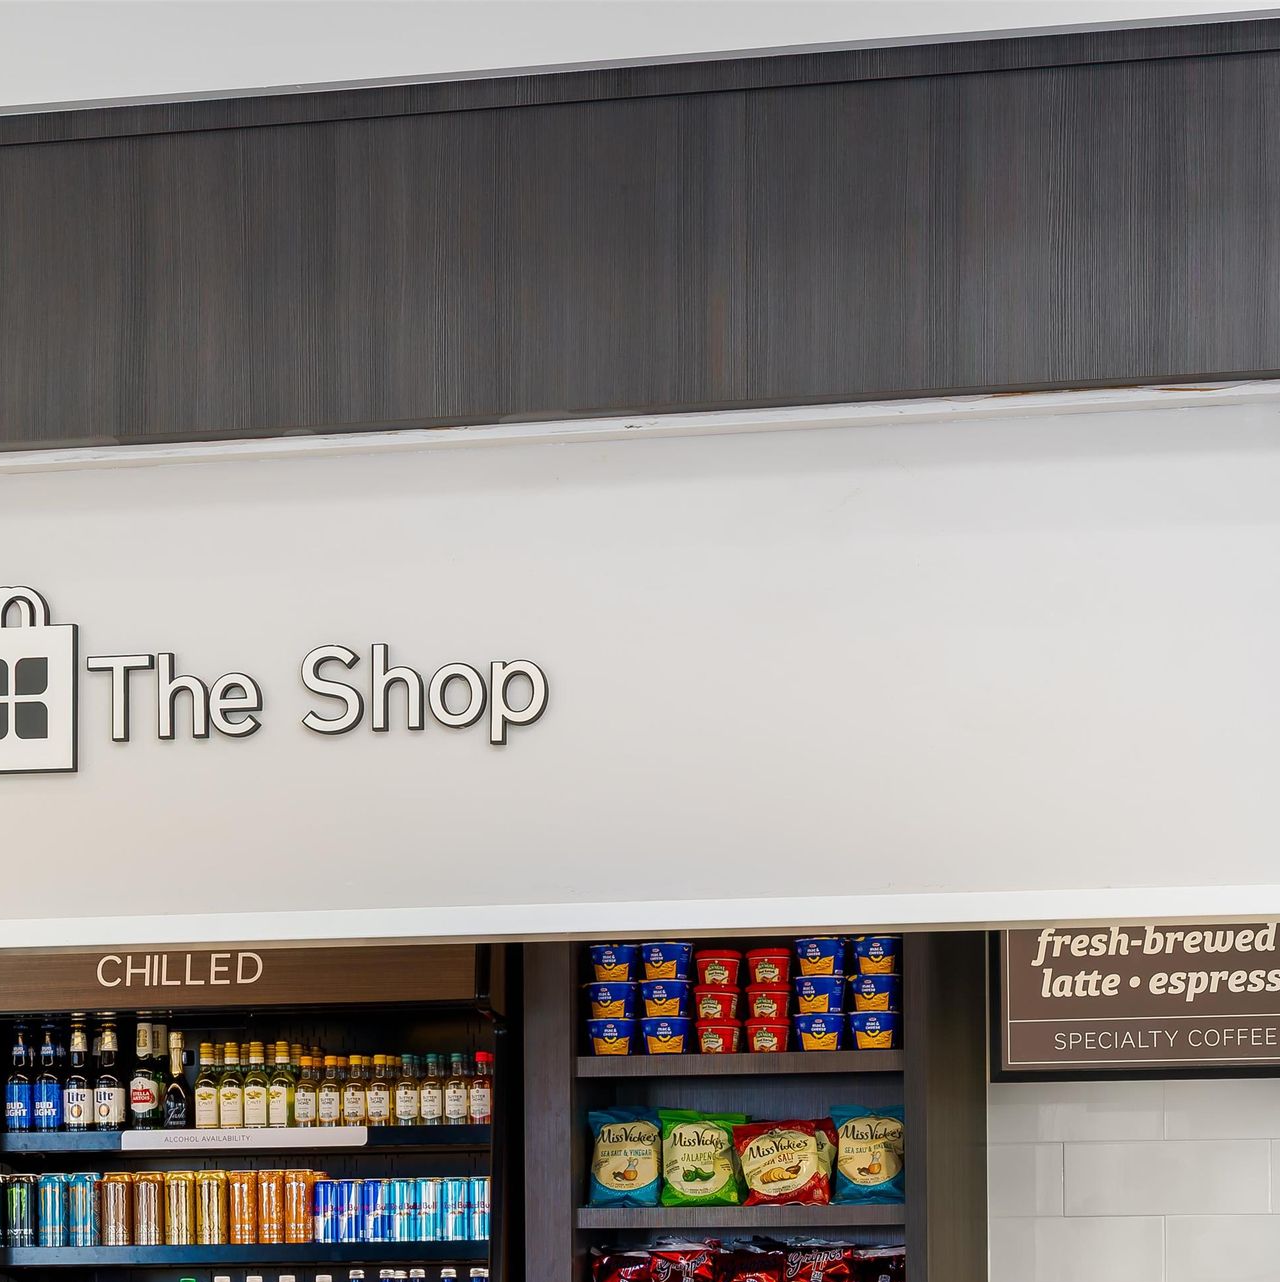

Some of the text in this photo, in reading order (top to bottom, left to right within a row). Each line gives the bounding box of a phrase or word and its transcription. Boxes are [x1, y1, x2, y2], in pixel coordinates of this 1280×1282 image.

[86, 642, 549, 746] The Shop
[1031, 924, 1276, 966] fresh-brewed
[96, 951, 264, 988] CHILLED
[1041, 968, 1120, 998] latte
[1054, 1030, 1179, 1050] SPECIALTY
[1188, 1028, 1277, 1047] COFFEE
[67, 1092, 86, 1102] Lite
[96, 1090, 113, 1102] Lite
[598, 1128, 657, 1145] Miss Vickie's
[842, 1125, 867, 1142] Miss
[748, 1144, 777, 1160] Miss
